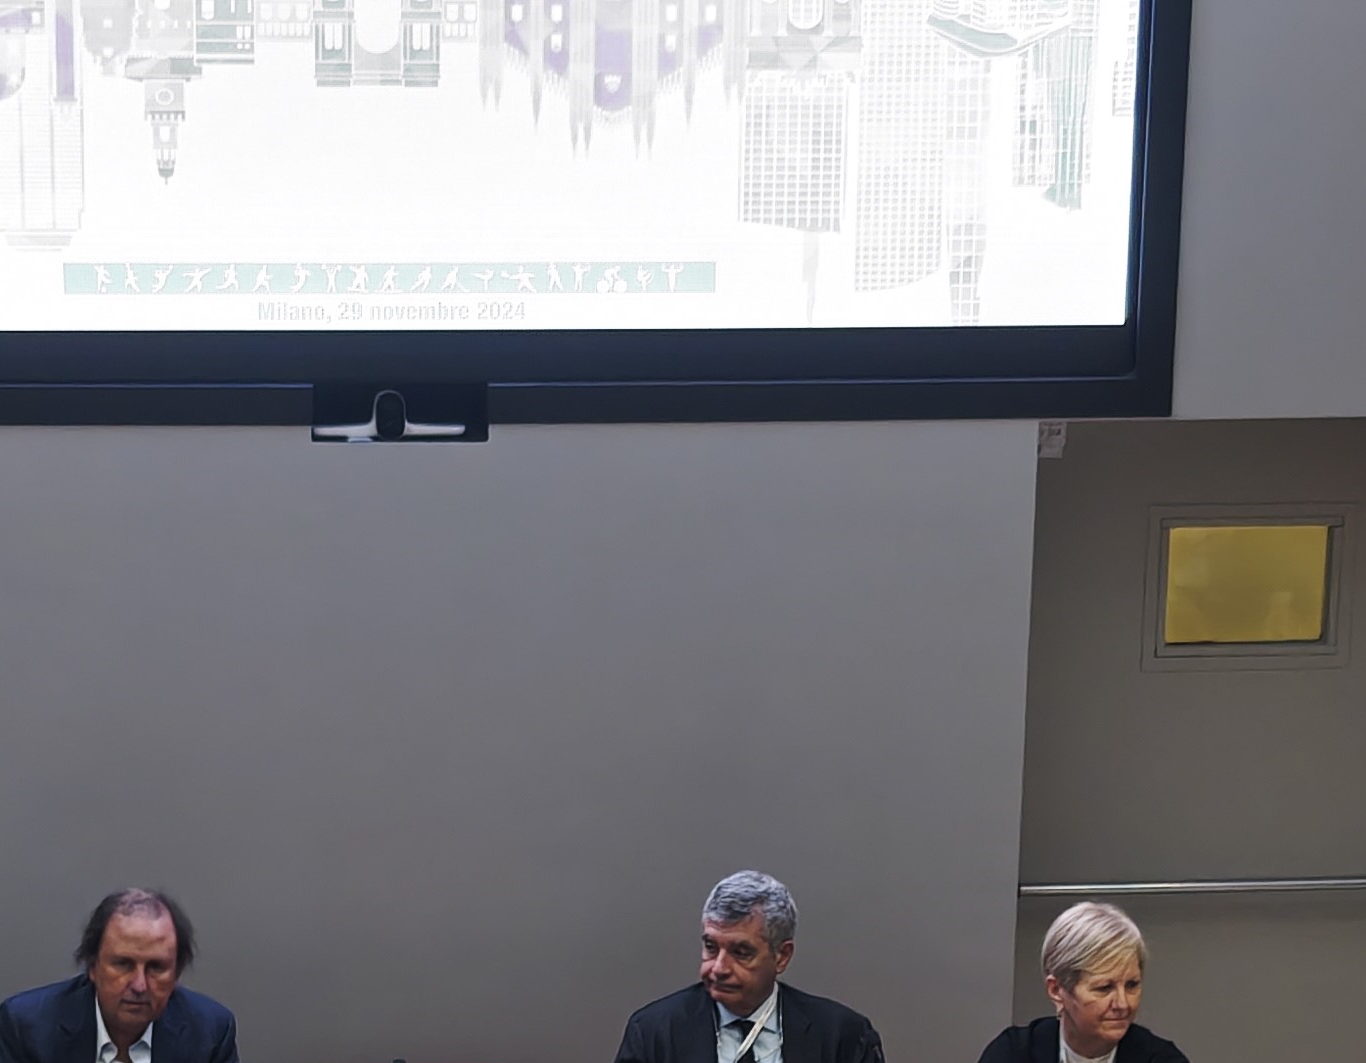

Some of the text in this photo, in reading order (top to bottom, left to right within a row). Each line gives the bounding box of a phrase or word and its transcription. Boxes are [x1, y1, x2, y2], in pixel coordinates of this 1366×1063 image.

[257, 300, 526, 324] Milano, 29 novembre 2024
